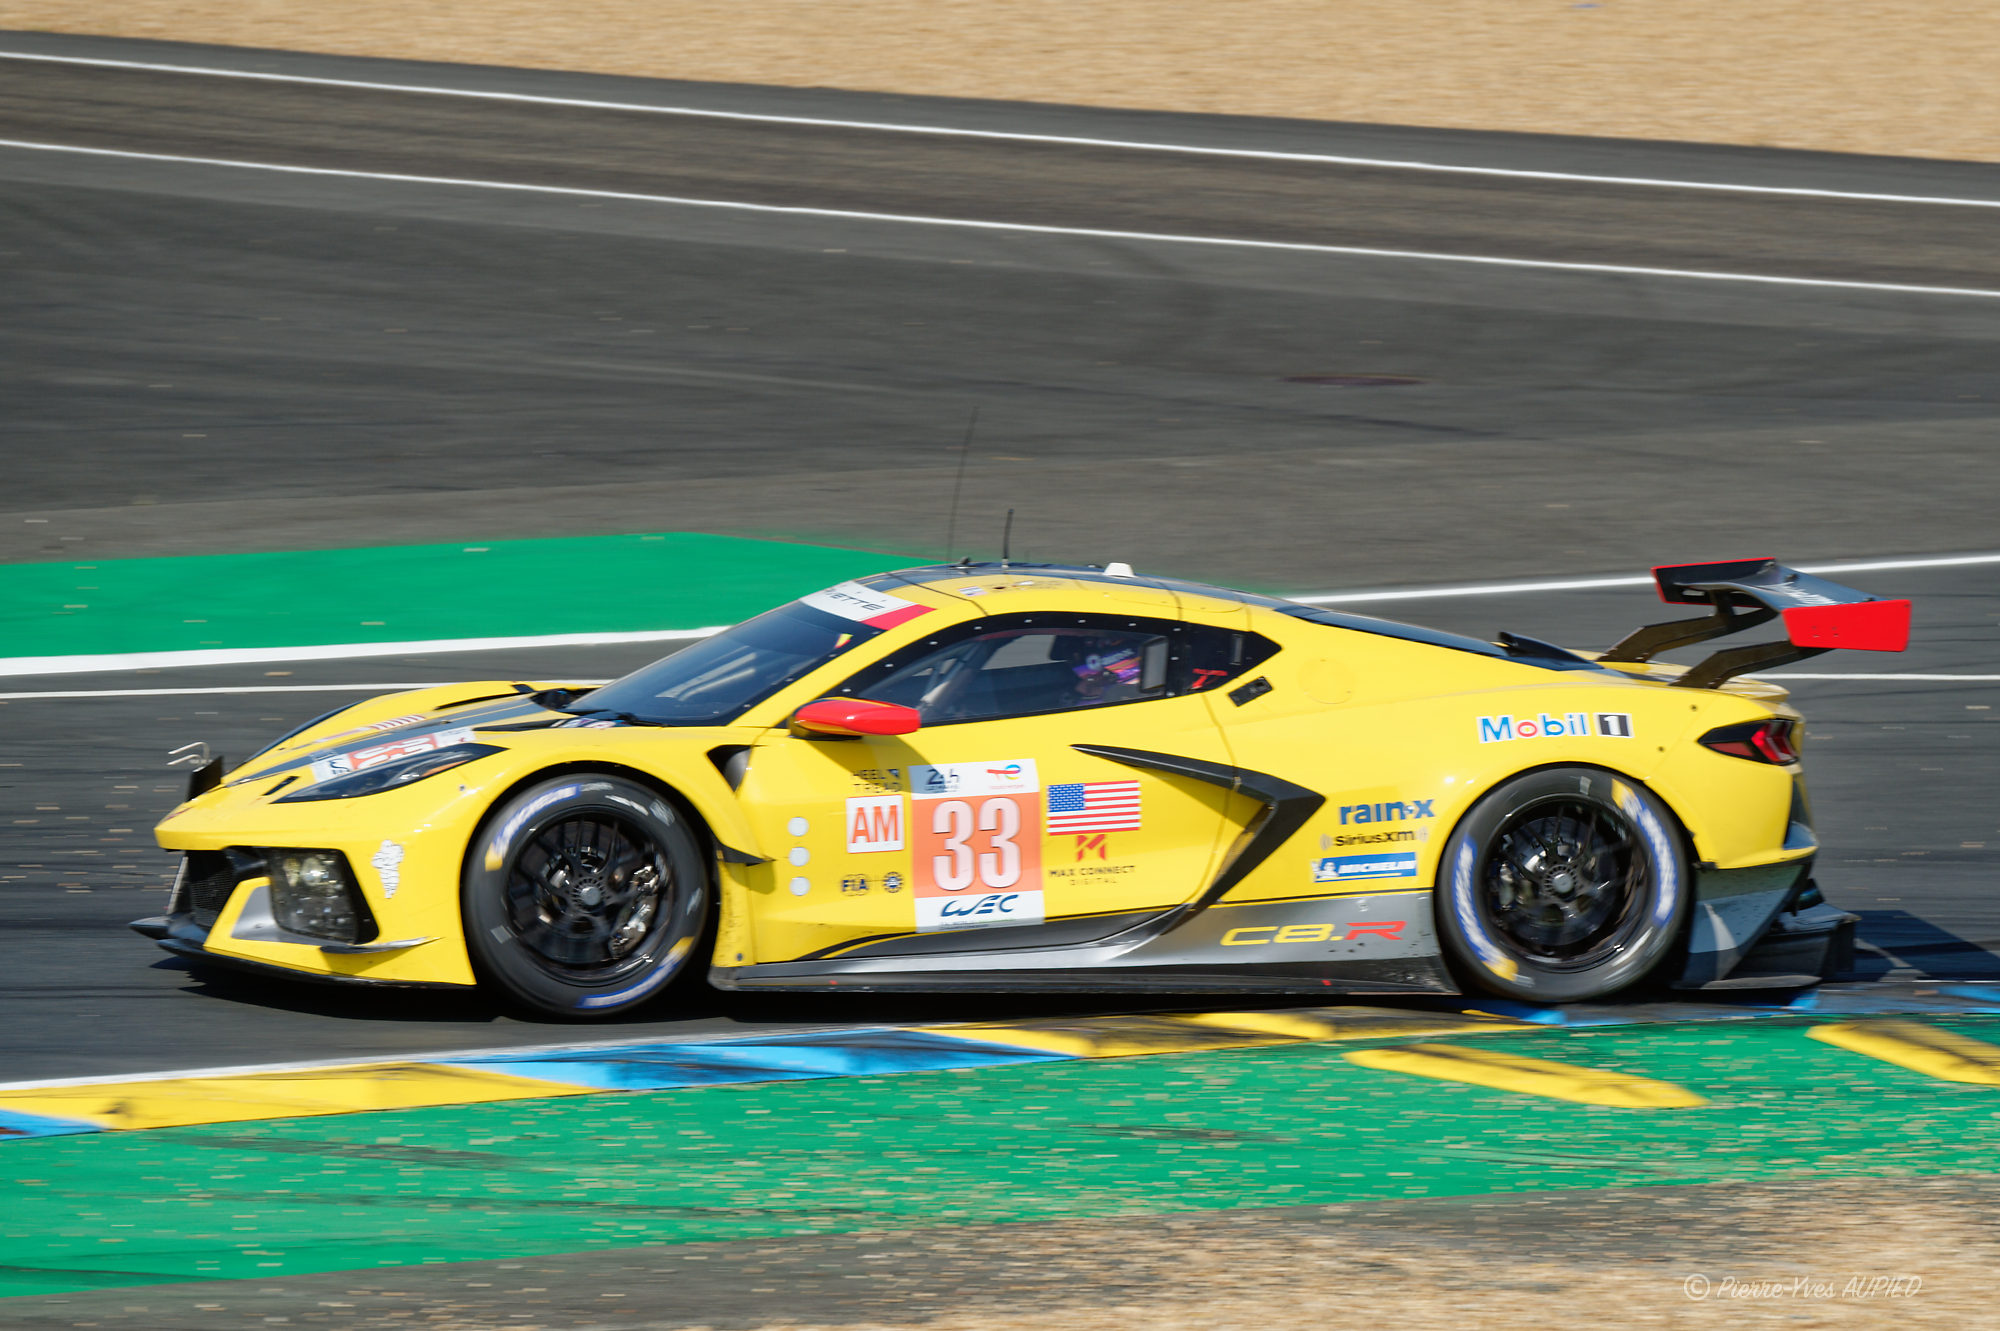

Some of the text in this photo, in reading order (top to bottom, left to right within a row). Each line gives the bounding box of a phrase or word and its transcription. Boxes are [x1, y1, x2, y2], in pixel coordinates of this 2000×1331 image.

[1479, 713, 1627, 742] Mobil 1
[850, 804, 900, 844] AM
[932, 797, 1022, 892] 33
[940, 894, 1019, 917] WEC
[1220, 921, 1407, 946] C8.R
